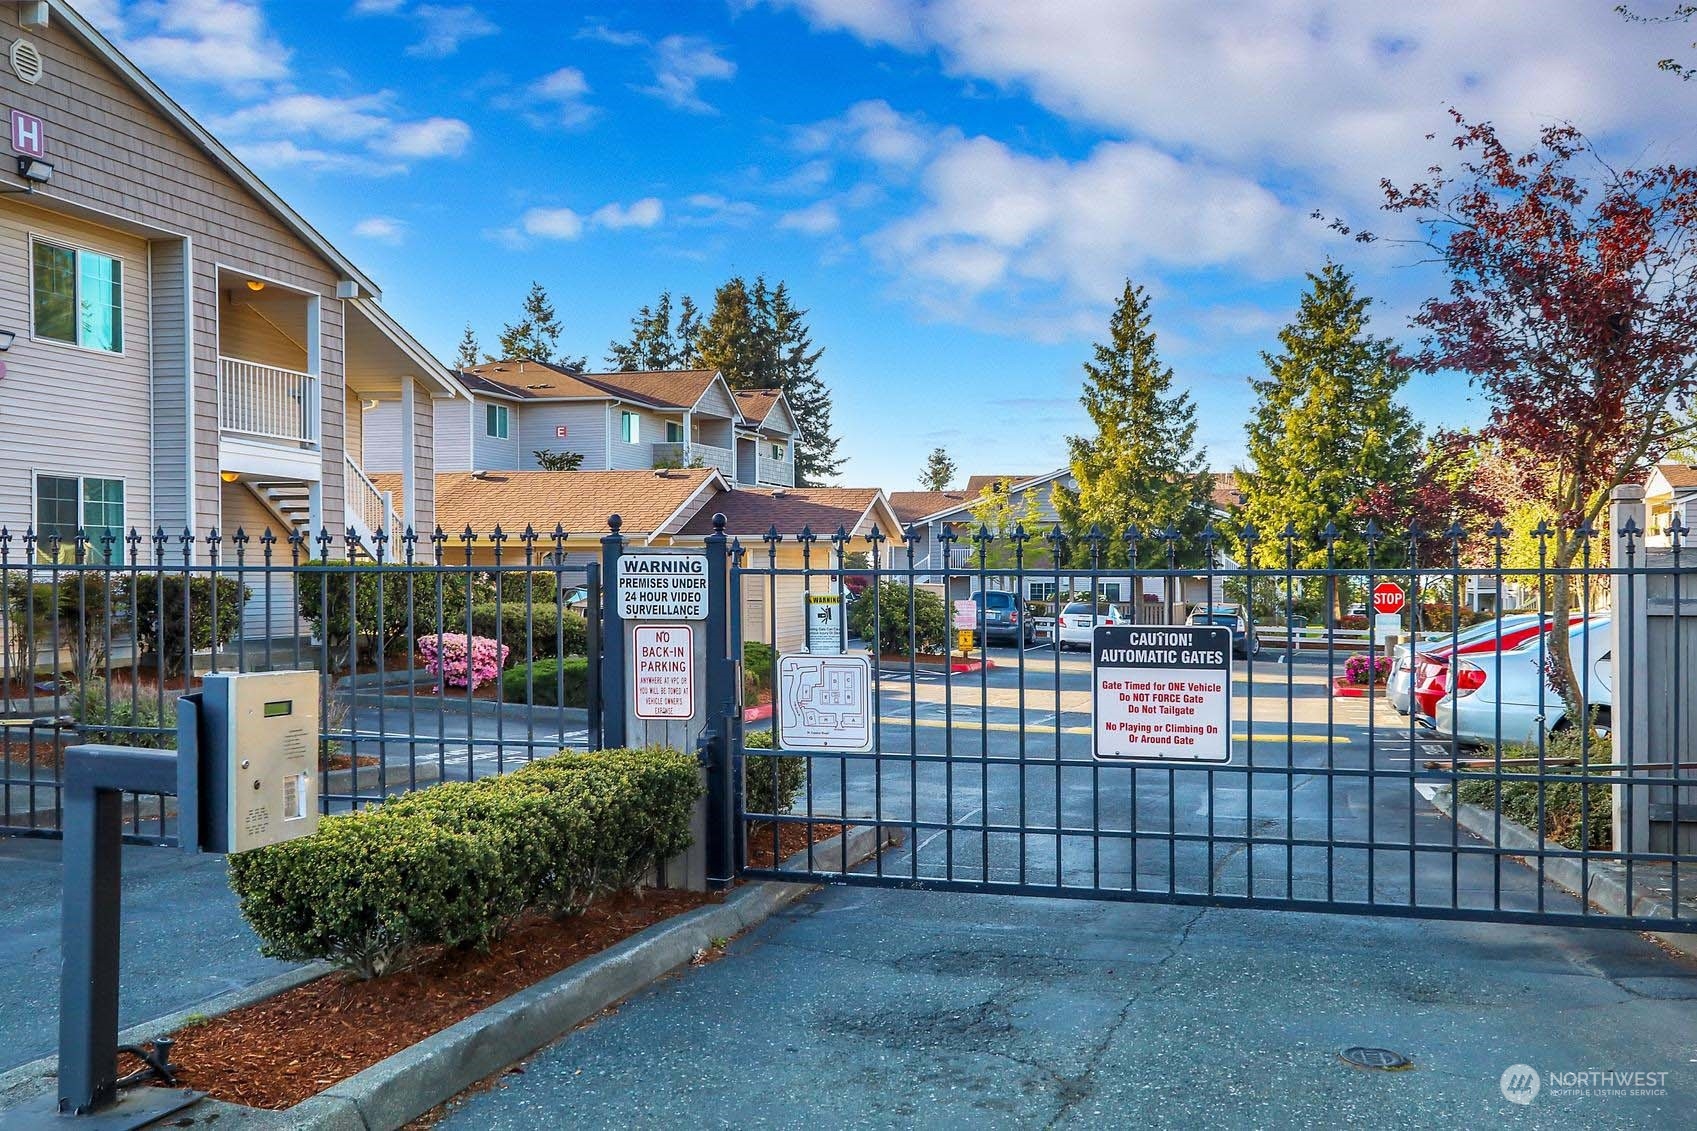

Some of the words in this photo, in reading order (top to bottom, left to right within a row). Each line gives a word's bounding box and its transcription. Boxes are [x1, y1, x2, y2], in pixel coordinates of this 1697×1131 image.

[18, 116, 38, 152] H
[557, 427, 565, 437] E
[624, 560, 702, 573] WARNING
[619, 578, 669, 588] PREMISES
[672, 578, 706, 589] UNDER
[625, 592, 636, 601] 24
[639, 592, 668, 602] HOUR
[670, 592, 701, 602] VIDEO
[1373, 592, 1403, 605] STOP
[626, 604, 700, 615] SURVEILLANCE
[656, 632, 669, 642] NO
[1129, 632, 1193, 646] CAUTION!
[642, 646, 684, 657] BACK-IN
[1100, 649, 1178, 663] AUTOMATIC
[1181, 650, 1223, 664] GATES
[640, 661, 686, 672] PARKING
[1102, 681, 1122, 690] Gate
[1125, 681, 1150, 690] Timed
[1153, 682, 1165, 691] for
[1168, 682, 1185, 691] ONE
[1188, 683, 1221, 692] Vehicle
[646, 697, 663, 705] VEHICLE
[1119, 692, 1130, 701] Do
[1133, 693, 1150, 702] NOT
[1152, 693, 1181, 703] FORCE
[1183, 694, 1204, 703] Gate
[1128, 705, 1139, 713] Do
[1142, 705, 1157, 714] Not
[1159, 705, 1195, 716] Tailgate
[1105, 722, 1117, 731] No
[1119, 722, 1152, 733] Playing
[1154, 724, 1163, 732] or
[1165, 723, 1204, 735] Climbing
[1206, 725, 1218, 734] On
[1129, 734, 1139, 743] Or
[1141, 735, 1171, 744] Around
[1174, 735, 1194, 745] Gate
